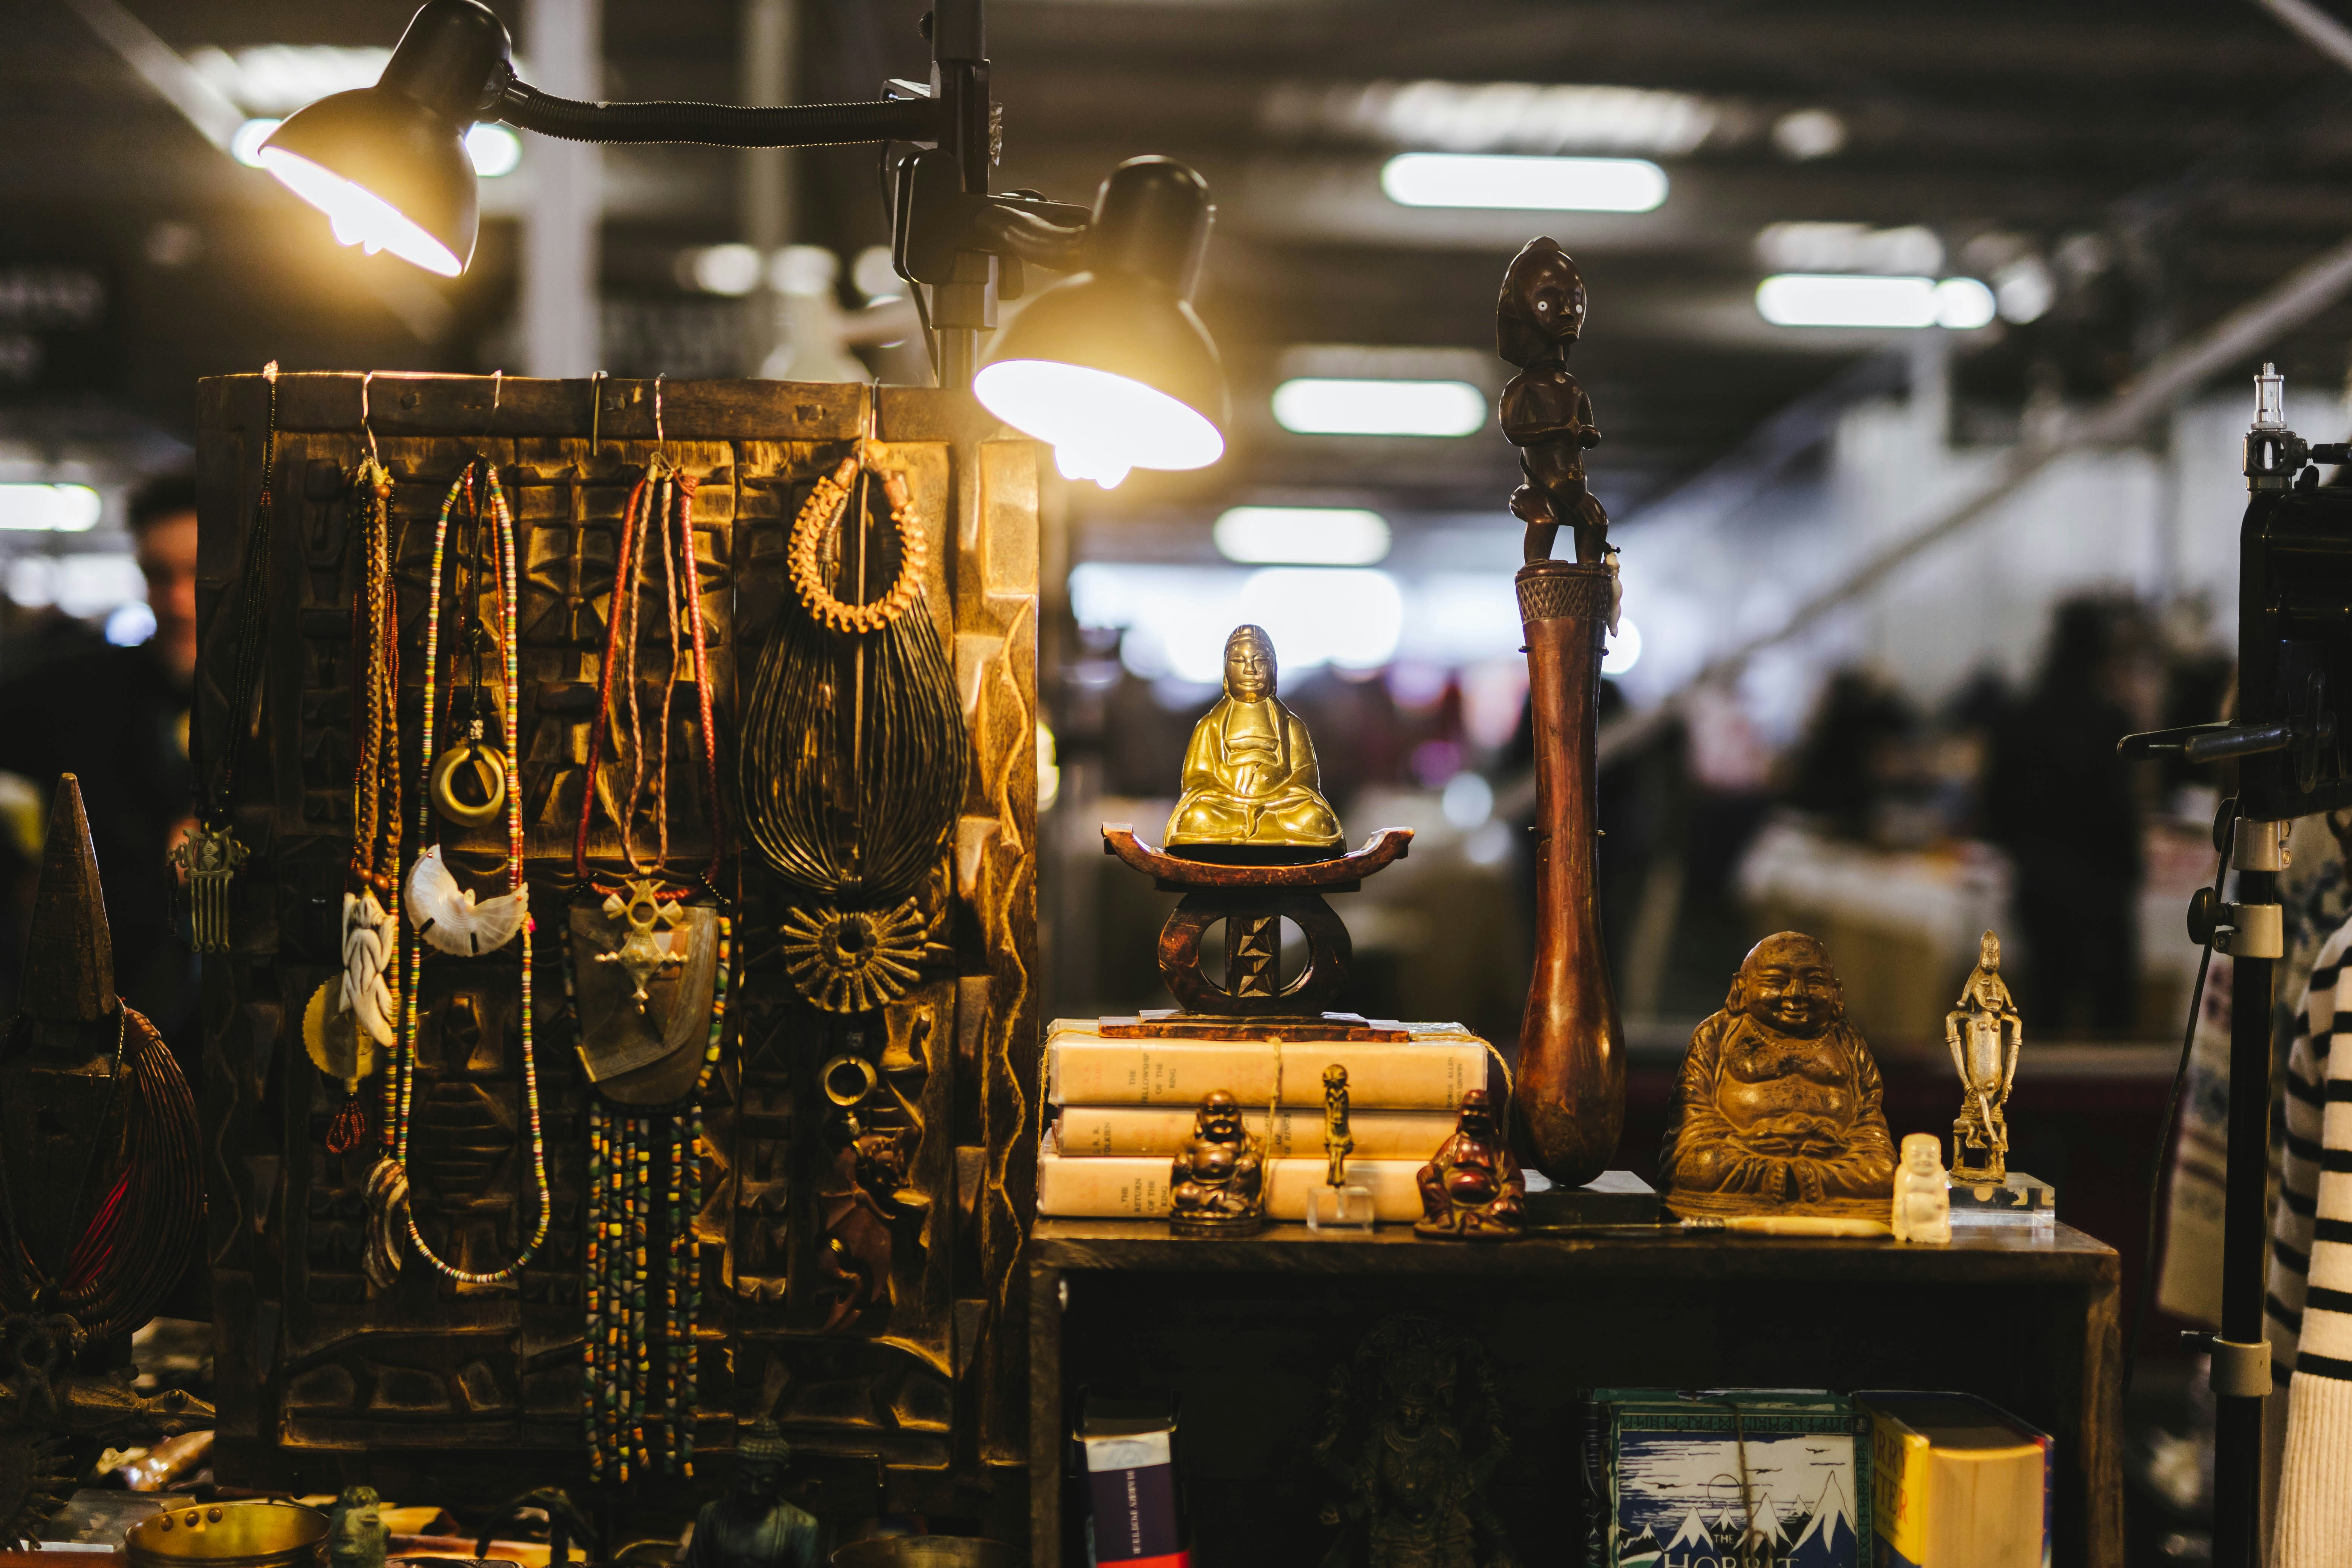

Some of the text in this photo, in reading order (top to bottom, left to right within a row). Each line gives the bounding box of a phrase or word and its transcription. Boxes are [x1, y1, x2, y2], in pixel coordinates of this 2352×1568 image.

[1156, 1083, 1162, 1095] OF
[1148, 1200, 1154, 1211] OF
[1713, 1534, 1735, 1544] THE
